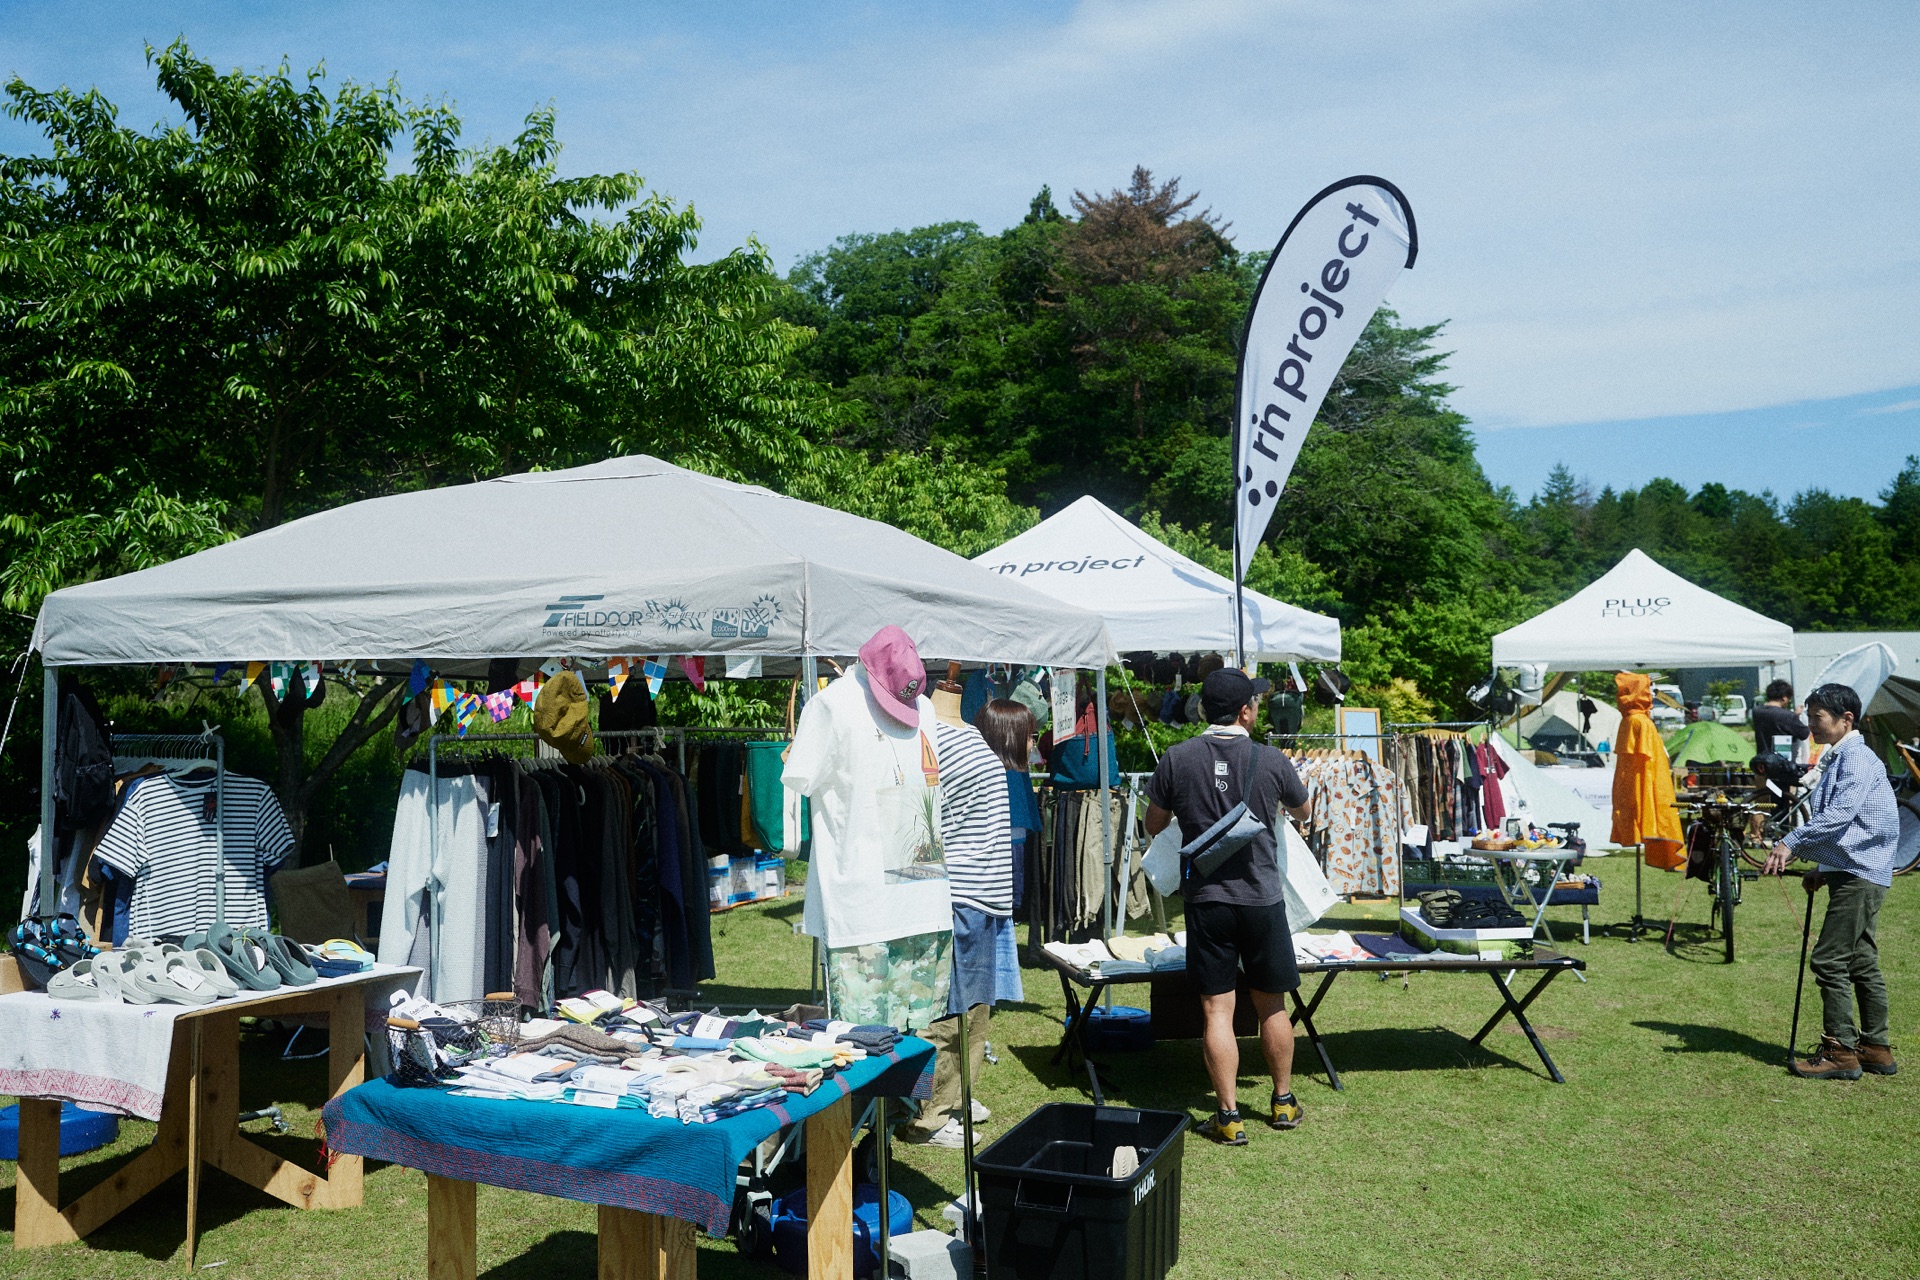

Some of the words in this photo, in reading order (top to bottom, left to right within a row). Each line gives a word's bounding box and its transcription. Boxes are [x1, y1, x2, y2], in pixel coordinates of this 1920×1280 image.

[1273, 201, 1380, 403] project
[1020, 555, 1145, 577] project
[1605, 597, 1671, 609] PLUG
[1602, 606, 1664, 618] FLUX
[565, 610, 643, 627] FIELDOOR
[542, 628, 577, 637] Powered
[742, 621, 760, 633] UV
